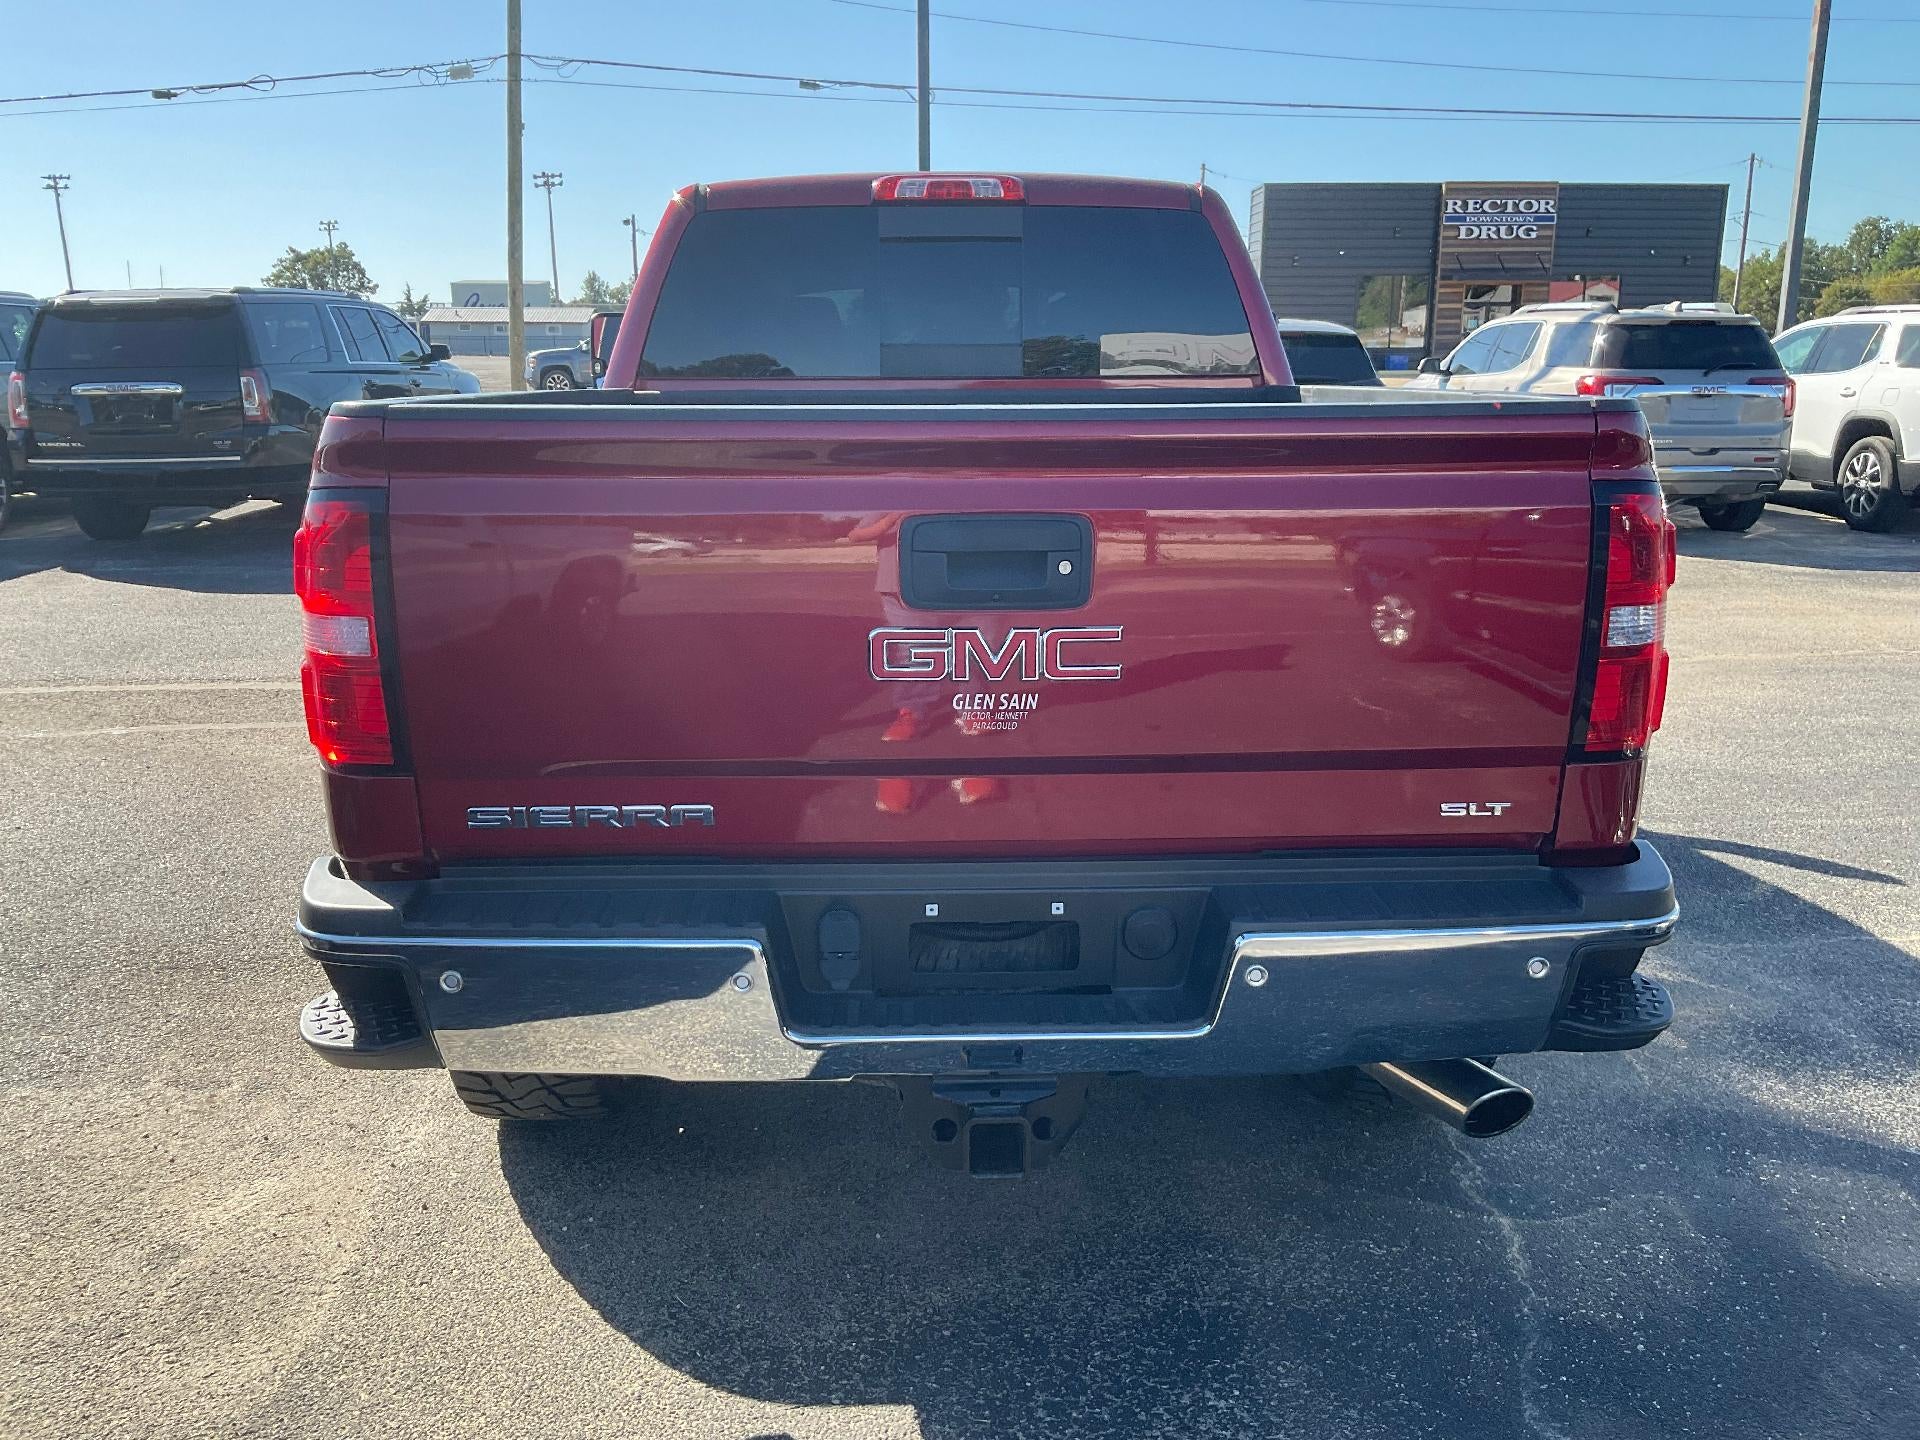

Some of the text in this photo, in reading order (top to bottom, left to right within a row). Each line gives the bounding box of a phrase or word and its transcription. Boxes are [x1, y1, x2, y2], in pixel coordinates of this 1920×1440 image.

[1445, 199, 1556, 213] RECTOR
[1458, 225, 1539, 239] DRUG
[1691, 386, 1727, 394] GMC
[868, 625, 1124, 682] GMC
[952, 693, 1039, 710] GLEN SAIN
[972, 721, 1018, 730] PARAGOULD
[1440, 802, 1512, 816] SLT
[467, 804, 715, 829] SIERRA
